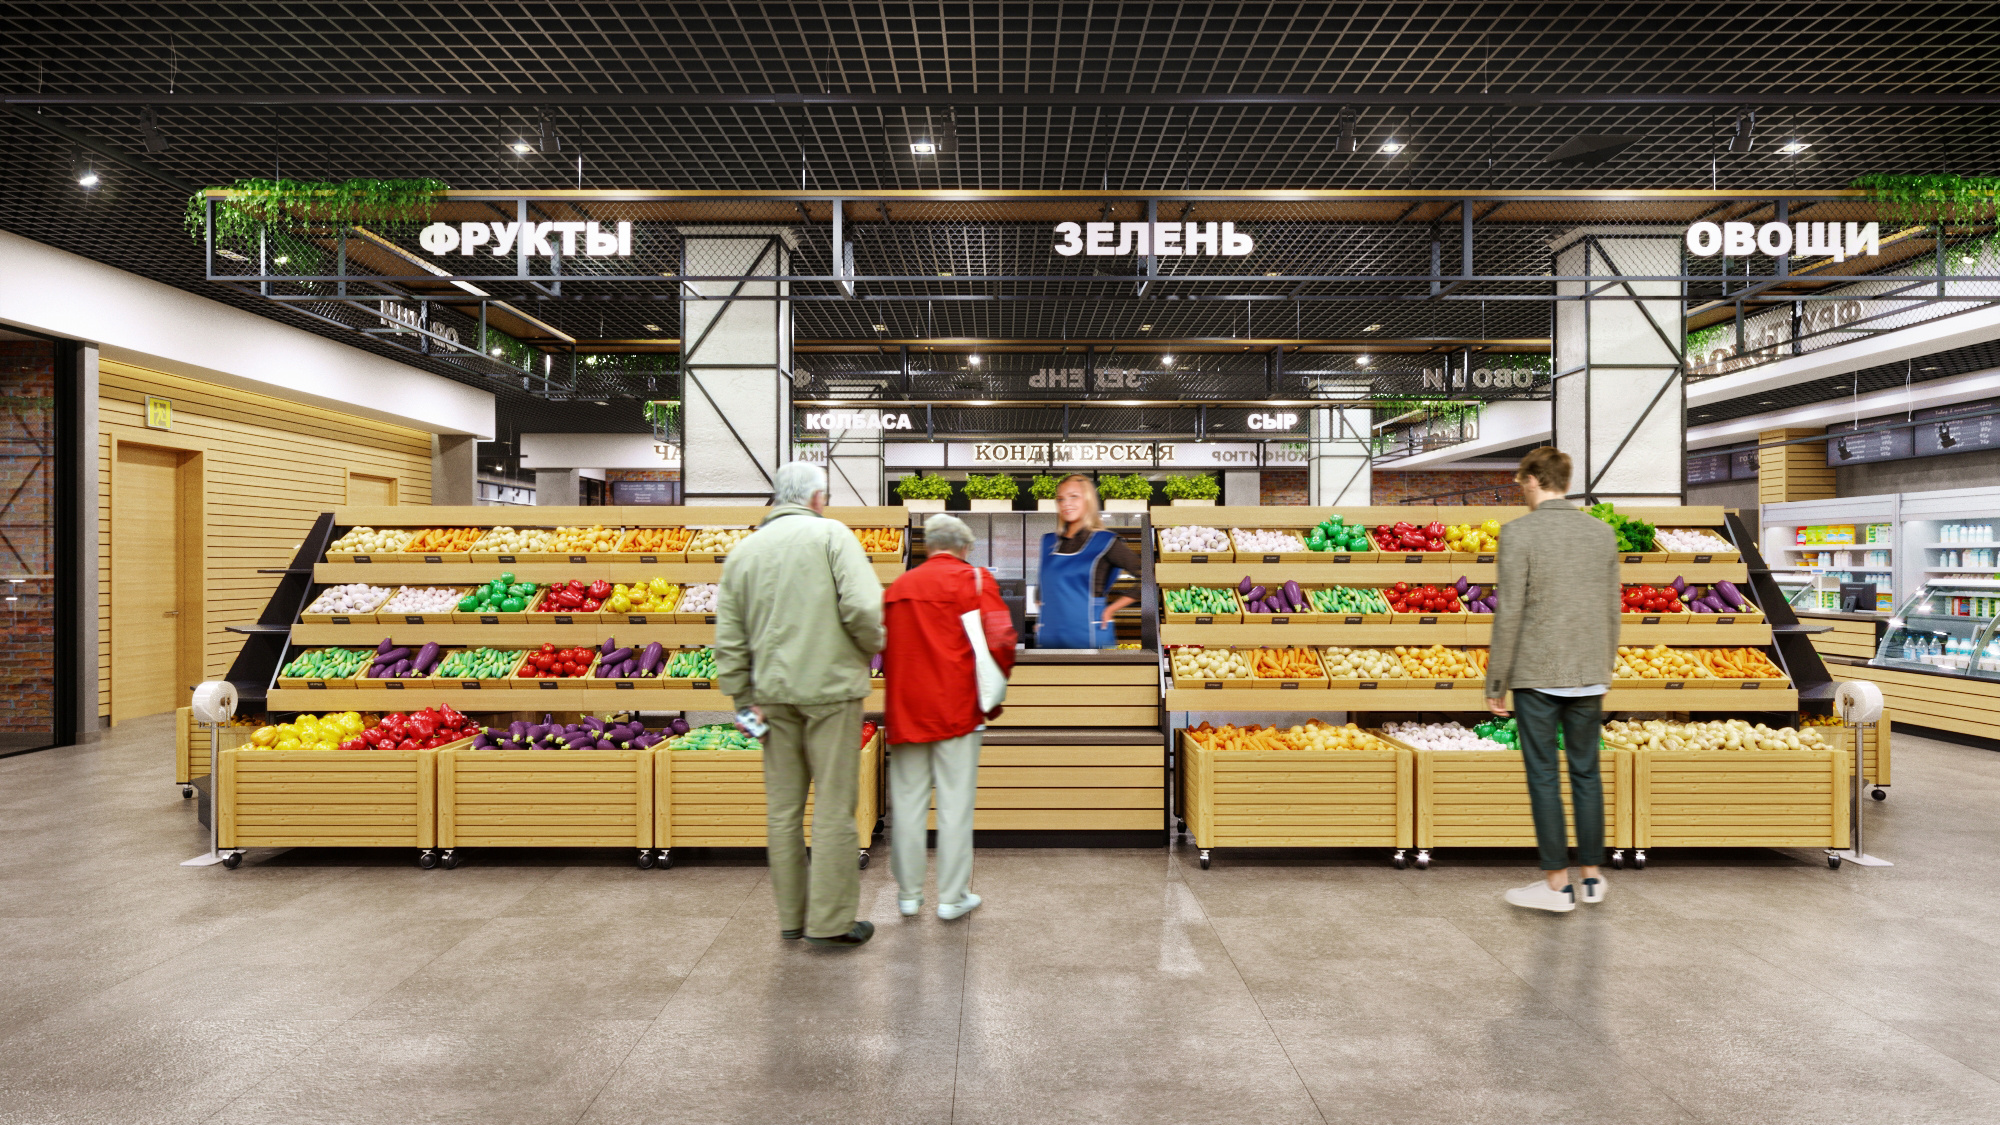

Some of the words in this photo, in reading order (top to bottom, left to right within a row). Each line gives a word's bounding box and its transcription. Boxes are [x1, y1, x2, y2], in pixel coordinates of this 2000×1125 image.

[419, 222, 631, 256] ФРУКТЫ
[1054, 221, 1254, 256] ЗЕЛЕНЬ
[1687, 221, 1880, 263] ОВОЩИ
[806, 413, 913, 430] КОЛБАСА
[1247, 413, 1298, 430] СЫР
[975, 444, 1175, 462] КОНДИТЕРСКАЯ
